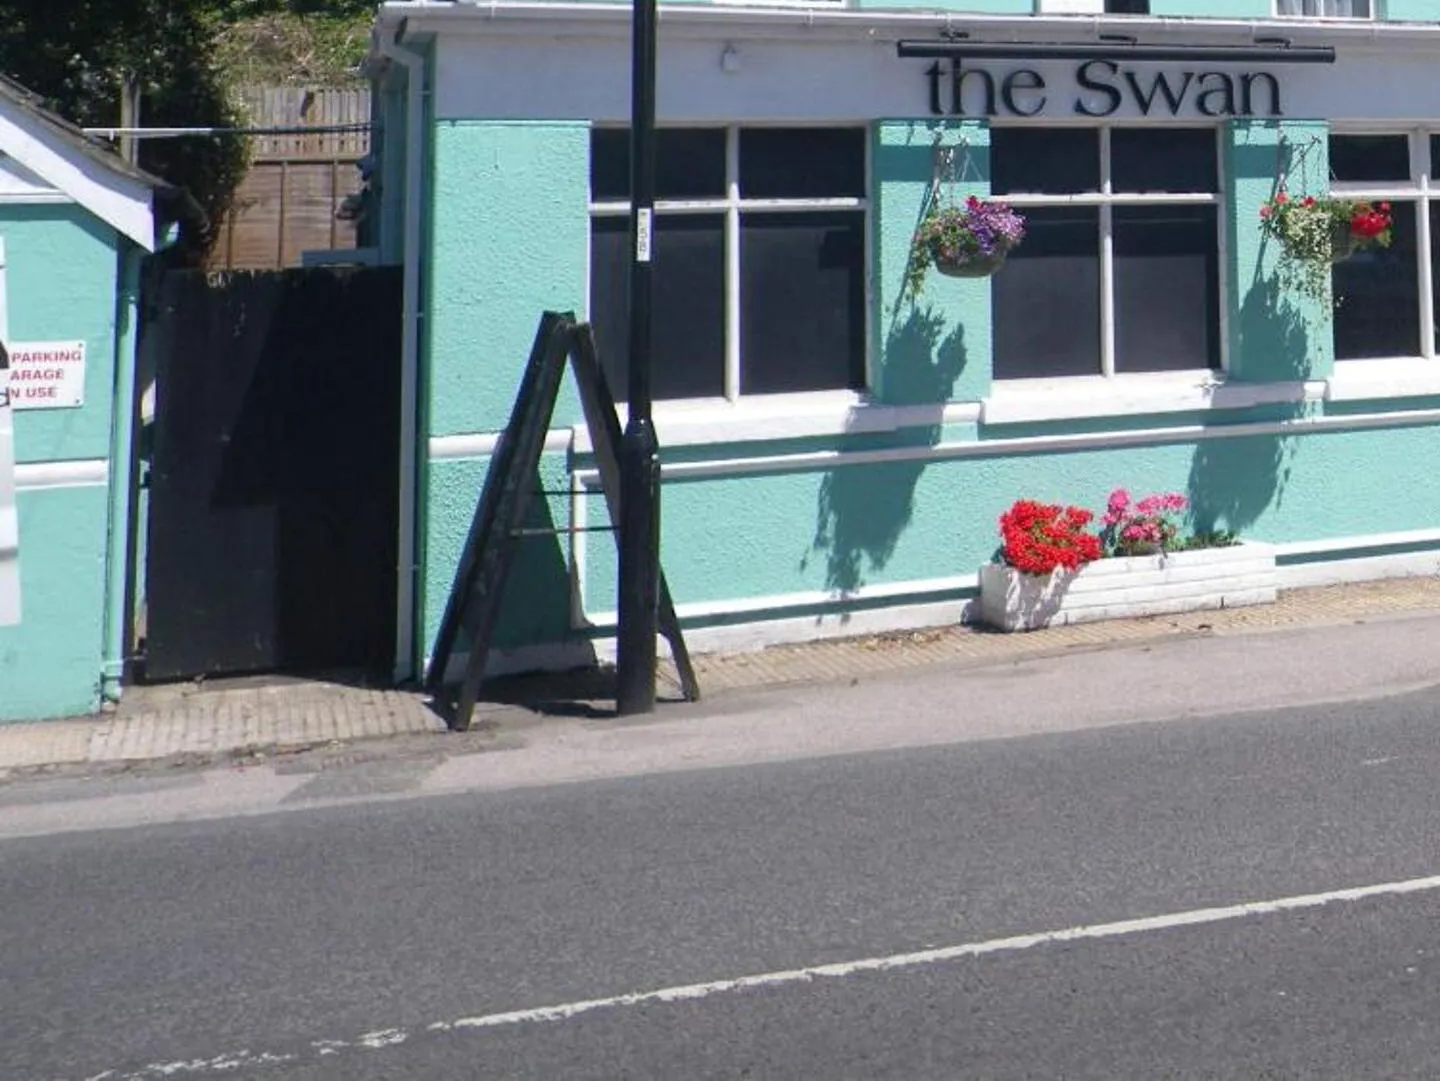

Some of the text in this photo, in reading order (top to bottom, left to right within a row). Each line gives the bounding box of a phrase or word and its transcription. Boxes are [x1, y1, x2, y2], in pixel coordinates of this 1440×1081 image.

[924, 56, 1284, 117] the Swan
[11, 349, 82, 363] PARKING
[10, 368, 65, 381] ARAGE
[10, 387, 20, 398] N
[26, 386, 57, 398] USE
